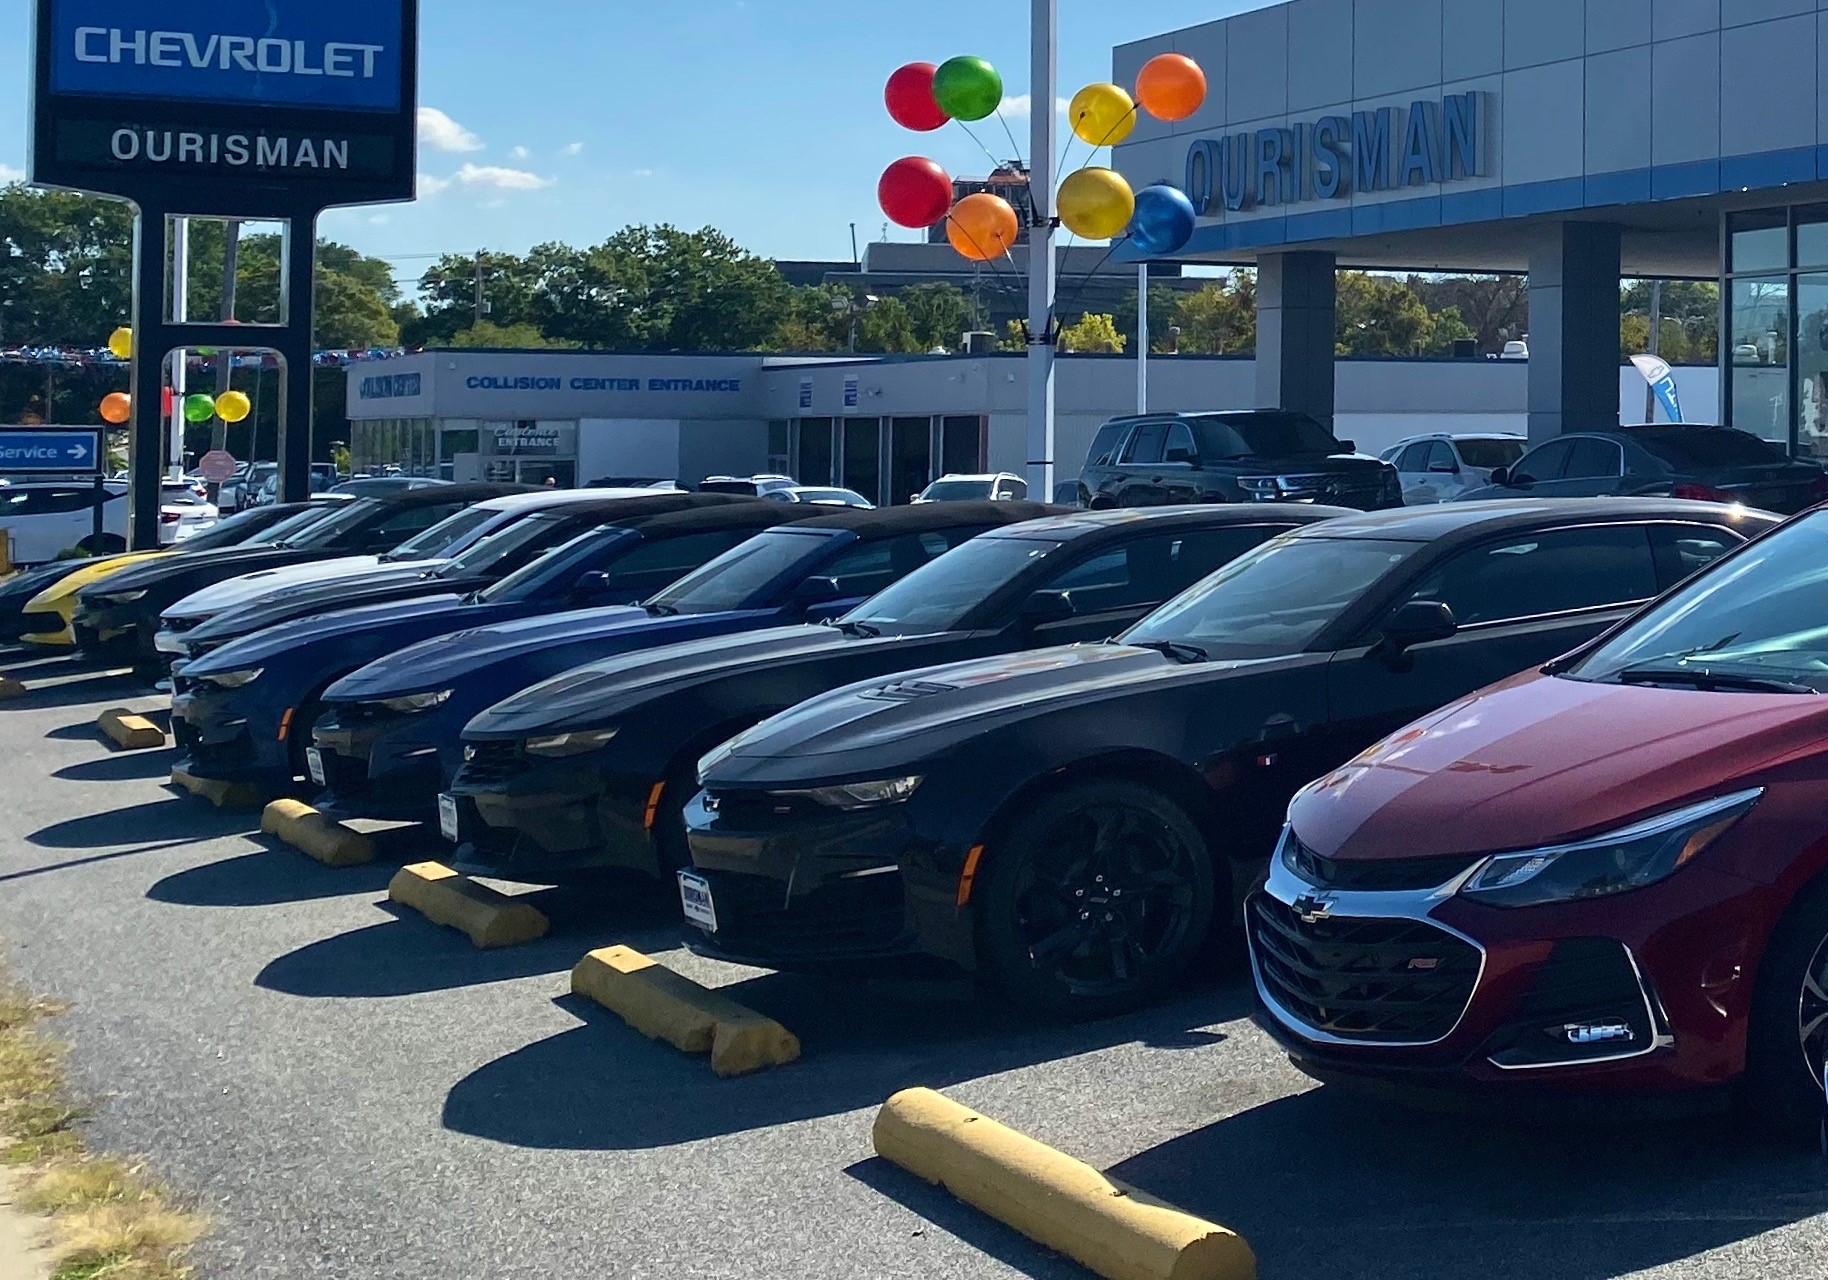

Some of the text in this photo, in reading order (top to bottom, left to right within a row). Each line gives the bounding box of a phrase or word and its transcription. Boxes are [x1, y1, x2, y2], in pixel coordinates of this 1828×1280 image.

[74, 26, 385, 79] CHEVROLET
[110, 128, 349, 170] OURISMAN
[1185, 91, 1486, 217] OURISMAN
[466, 376, 741, 392] COLLISION CENTER ENTRANCE
[498, 437, 561, 449] ENTRANCE
